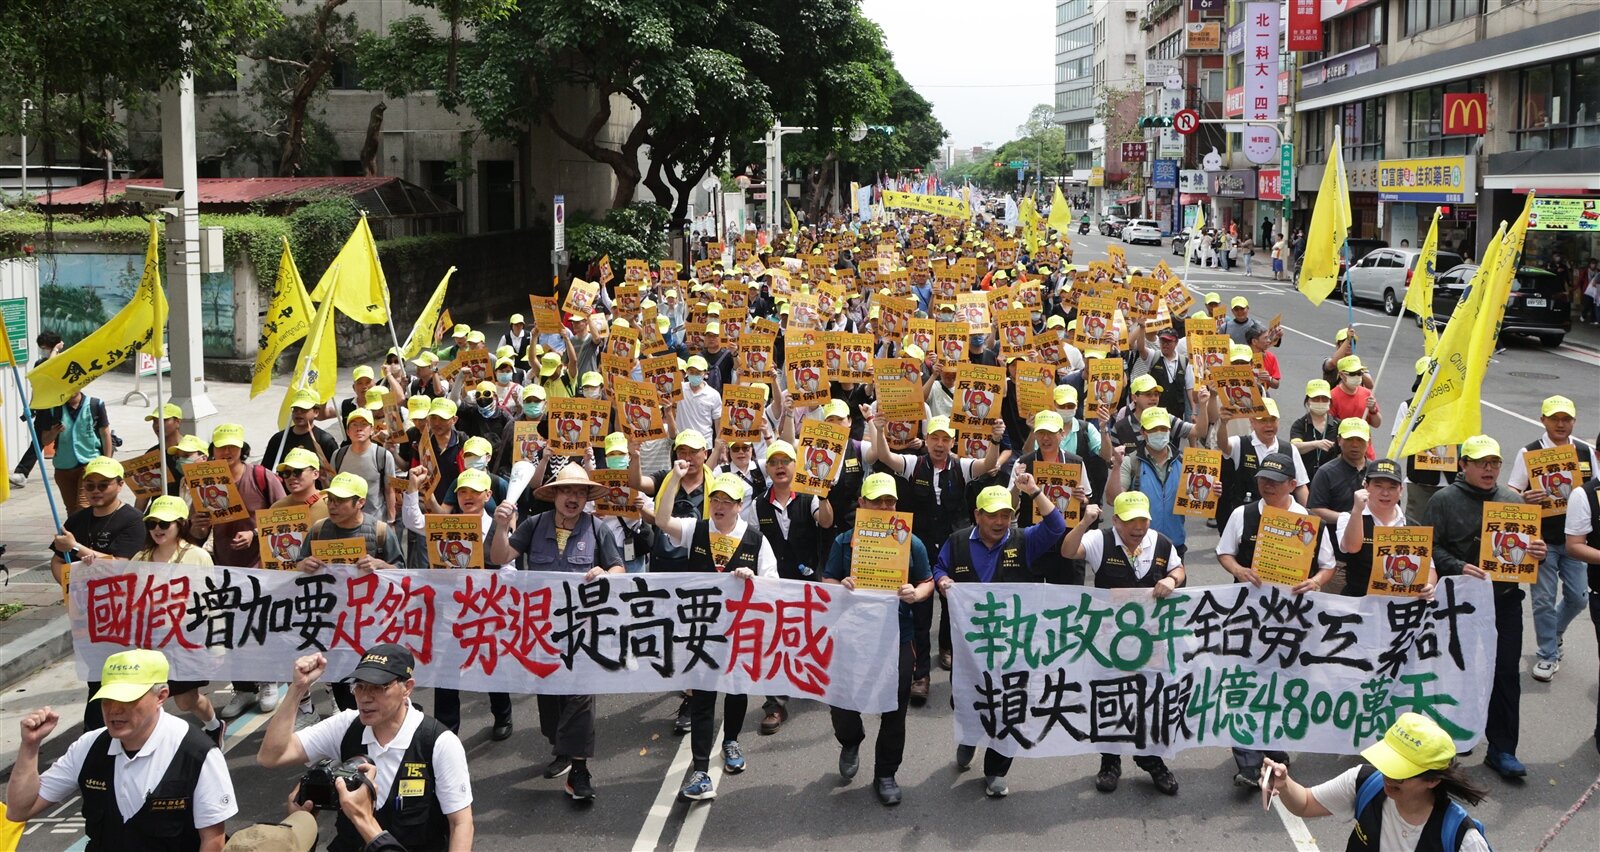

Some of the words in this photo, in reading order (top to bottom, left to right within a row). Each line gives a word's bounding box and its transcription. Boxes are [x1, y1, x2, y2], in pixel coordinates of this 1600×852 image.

[1080, 310, 1111, 319] 反霸凌
[938, 333, 967, 342] 反霸凌
[843, 345, 871, 353] 反霸凌
[789, 360, 826, 371] 反霸凌
[1091, 373, 1121, 381] 反霸凌
[958, 380, 1002, 394] 反霸凌
[1217, 380, 1256, 389] 反霸凌
[618, 394, 658, 409] 反霸凌
[551, 411, 589, 420] 反霸凌
[952, 413, 997, 427] 要保障
[723, 427, 761, 437] 要保障
[550, 440, 588, 450] 要保障
[801, 437, 844, 455] 反霸凌
[1417, 455, 1455, 465] 要保障
[1183, 464, 1219, 477] 反霸凌
[1531, 462, 1578, 479] 反霸凌
[190, 475, 231, 488] 反霸凌
[795, 471, 836, 489] 要保障
[1036, 477, 1078, 488] 反霸凌
[1177, 497, 1216, 511] 要保障
[1487, 511, 1538, 521] 五一勞工大遊行
[261, 524, 309, 538] 反霸凌
[1486, 521, 1538, 537] 反霸凌
[430, 532, 479, 542] 反霸凌
[1377, 544, 1429, 558] 反霸凌
[1483, 560, 1536, 574] 要保障
[1372, 580, 1427, 593] 要保障
[86, 569, 436, 665] 國假增加要足夠
[453, 571, 833, 687] 勞退提高要有感
